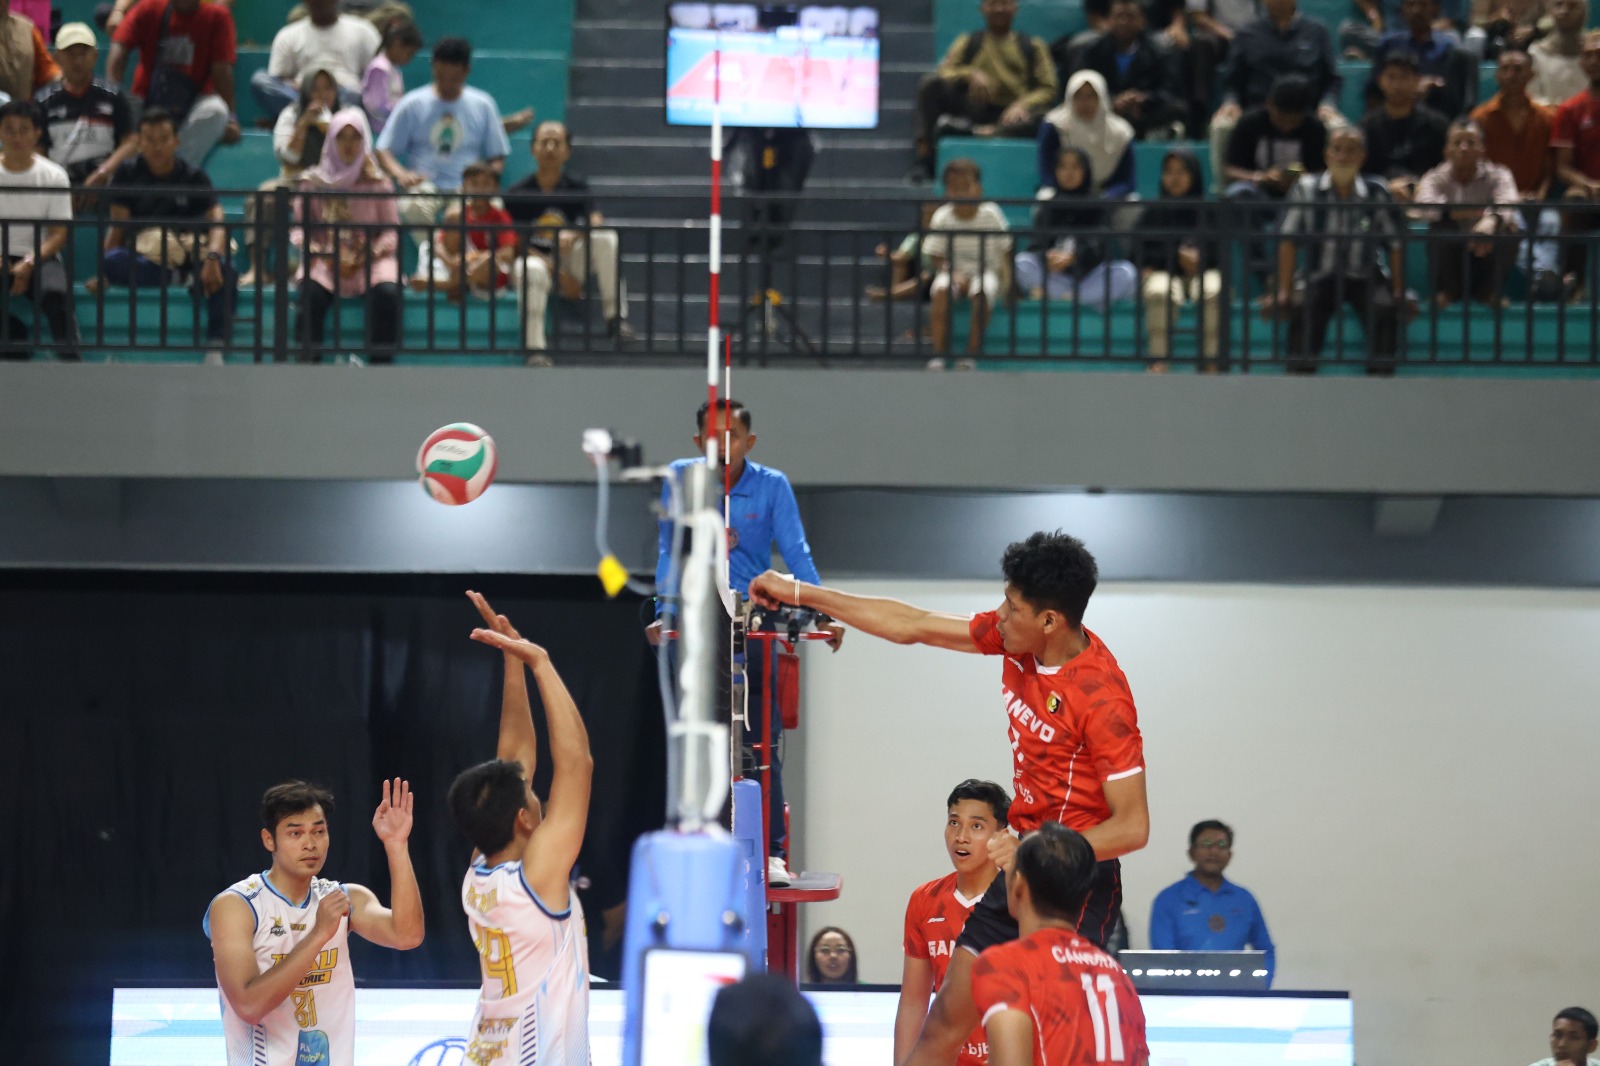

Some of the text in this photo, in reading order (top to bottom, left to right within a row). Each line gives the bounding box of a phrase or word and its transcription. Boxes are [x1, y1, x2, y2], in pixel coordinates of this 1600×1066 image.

[1003, 689, 1055, 743] ANEVO
[290, 988, 317, 1029] 81
[1081, 972, 1125, 1062] 11
